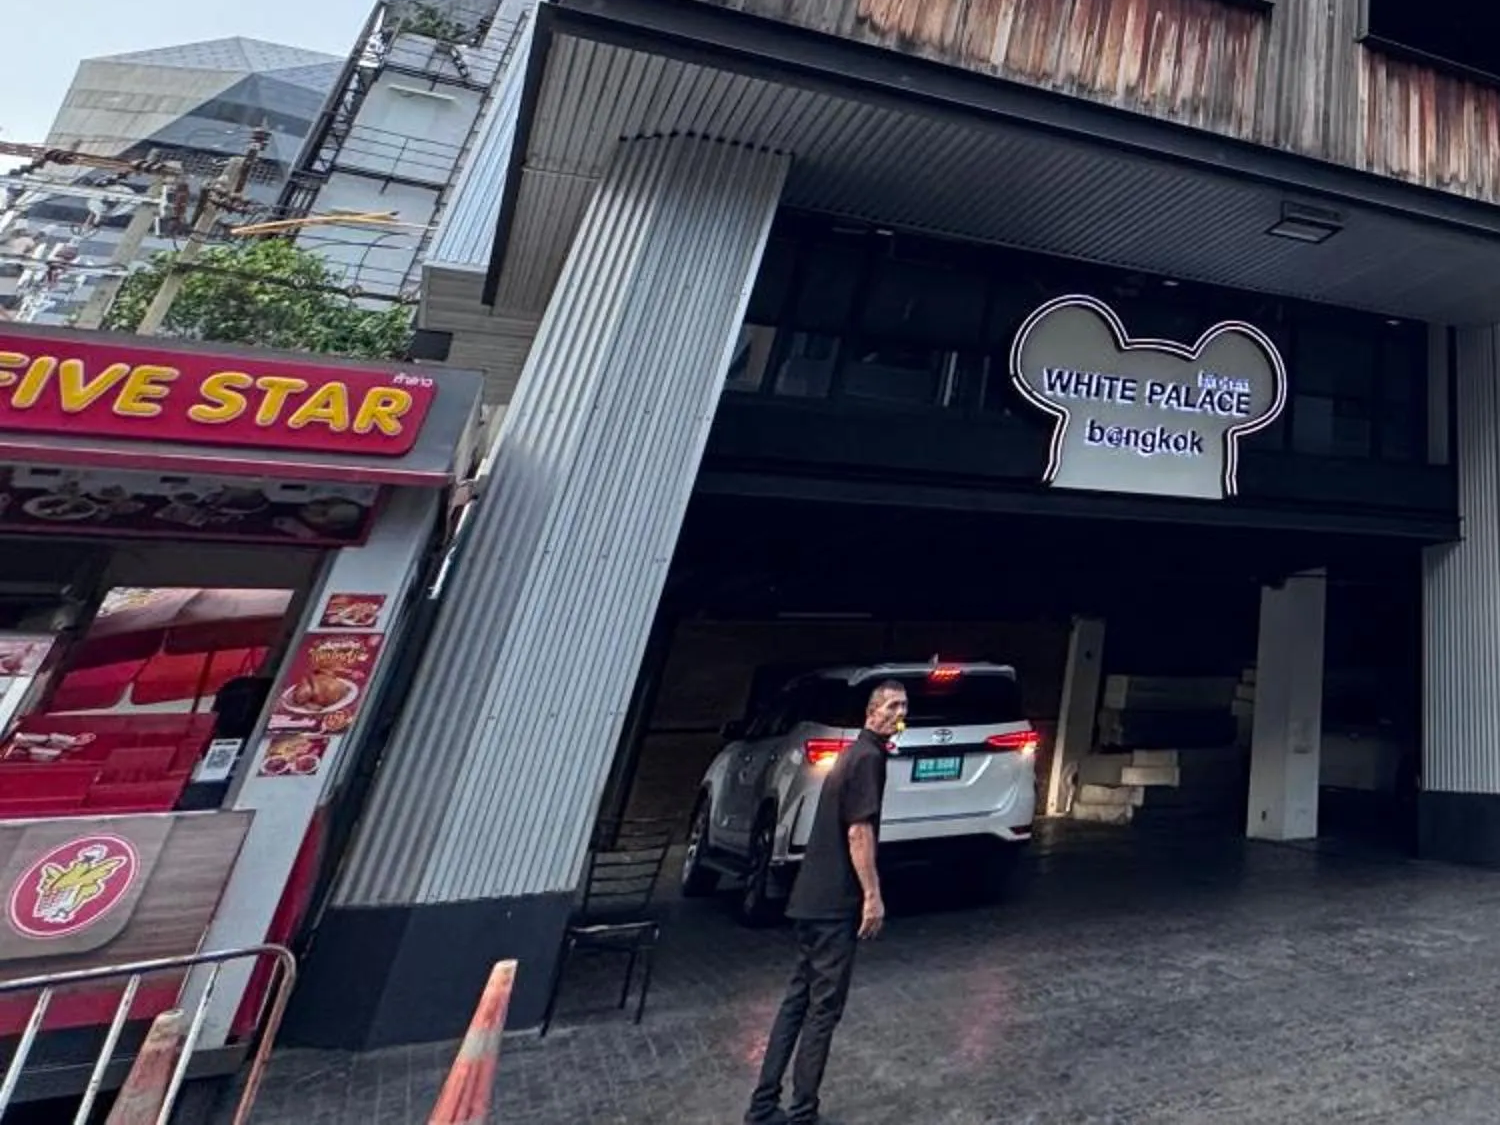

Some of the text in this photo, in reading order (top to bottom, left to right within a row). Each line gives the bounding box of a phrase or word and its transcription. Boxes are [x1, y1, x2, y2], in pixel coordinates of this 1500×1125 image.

[187, 372, 413, 436] STAR
[1043, 367, 1251, 417] WHITE PALACE
[1085, 418, 1204, 456] bangkok
